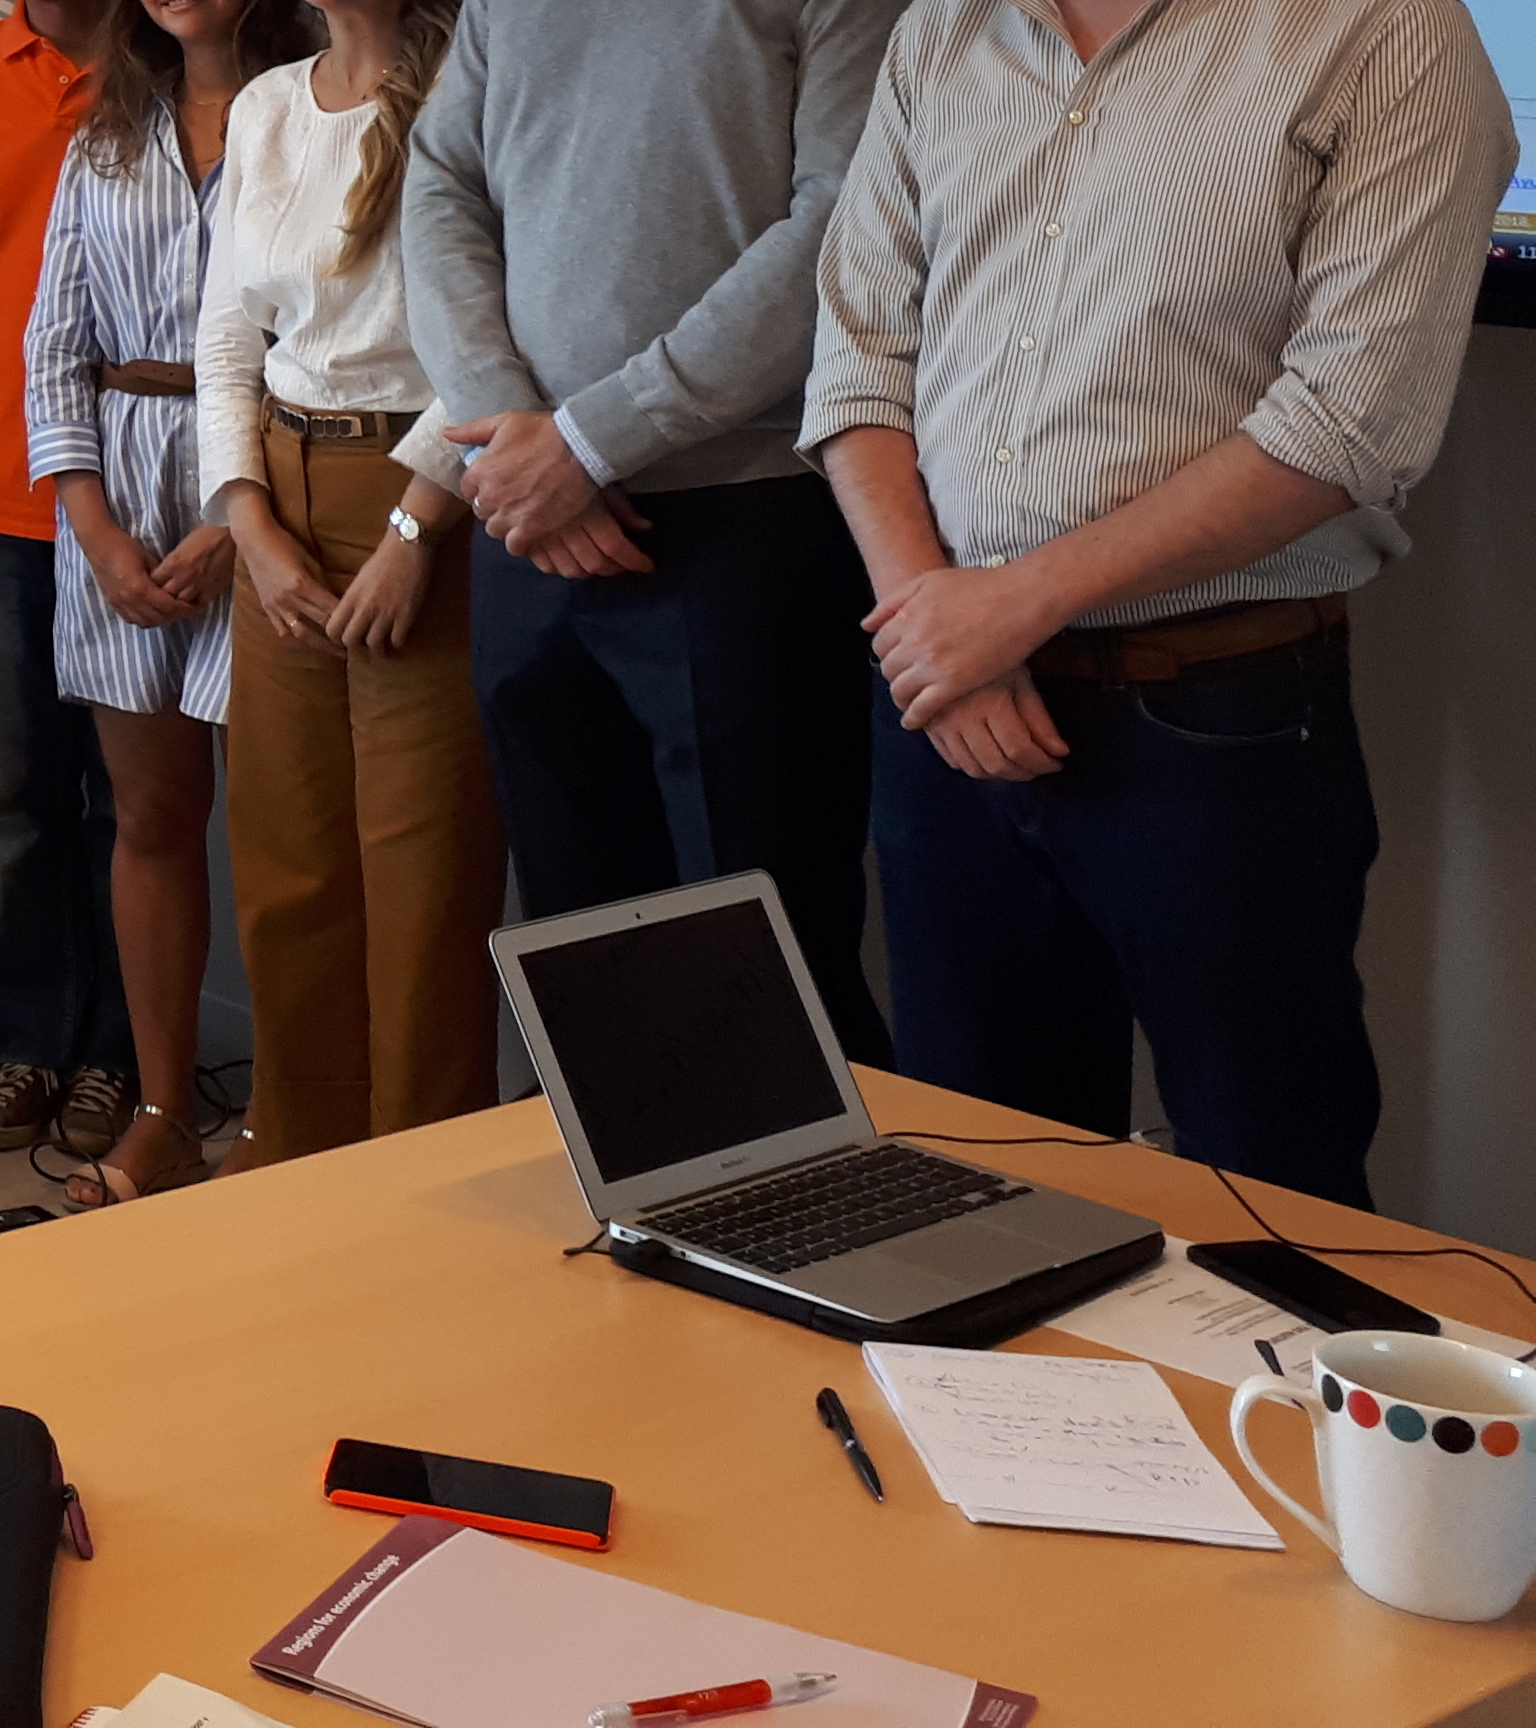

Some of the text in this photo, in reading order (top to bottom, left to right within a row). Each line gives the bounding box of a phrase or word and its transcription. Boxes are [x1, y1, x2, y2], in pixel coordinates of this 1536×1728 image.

[281, 1554, 400, 1656] Regions for economic change
